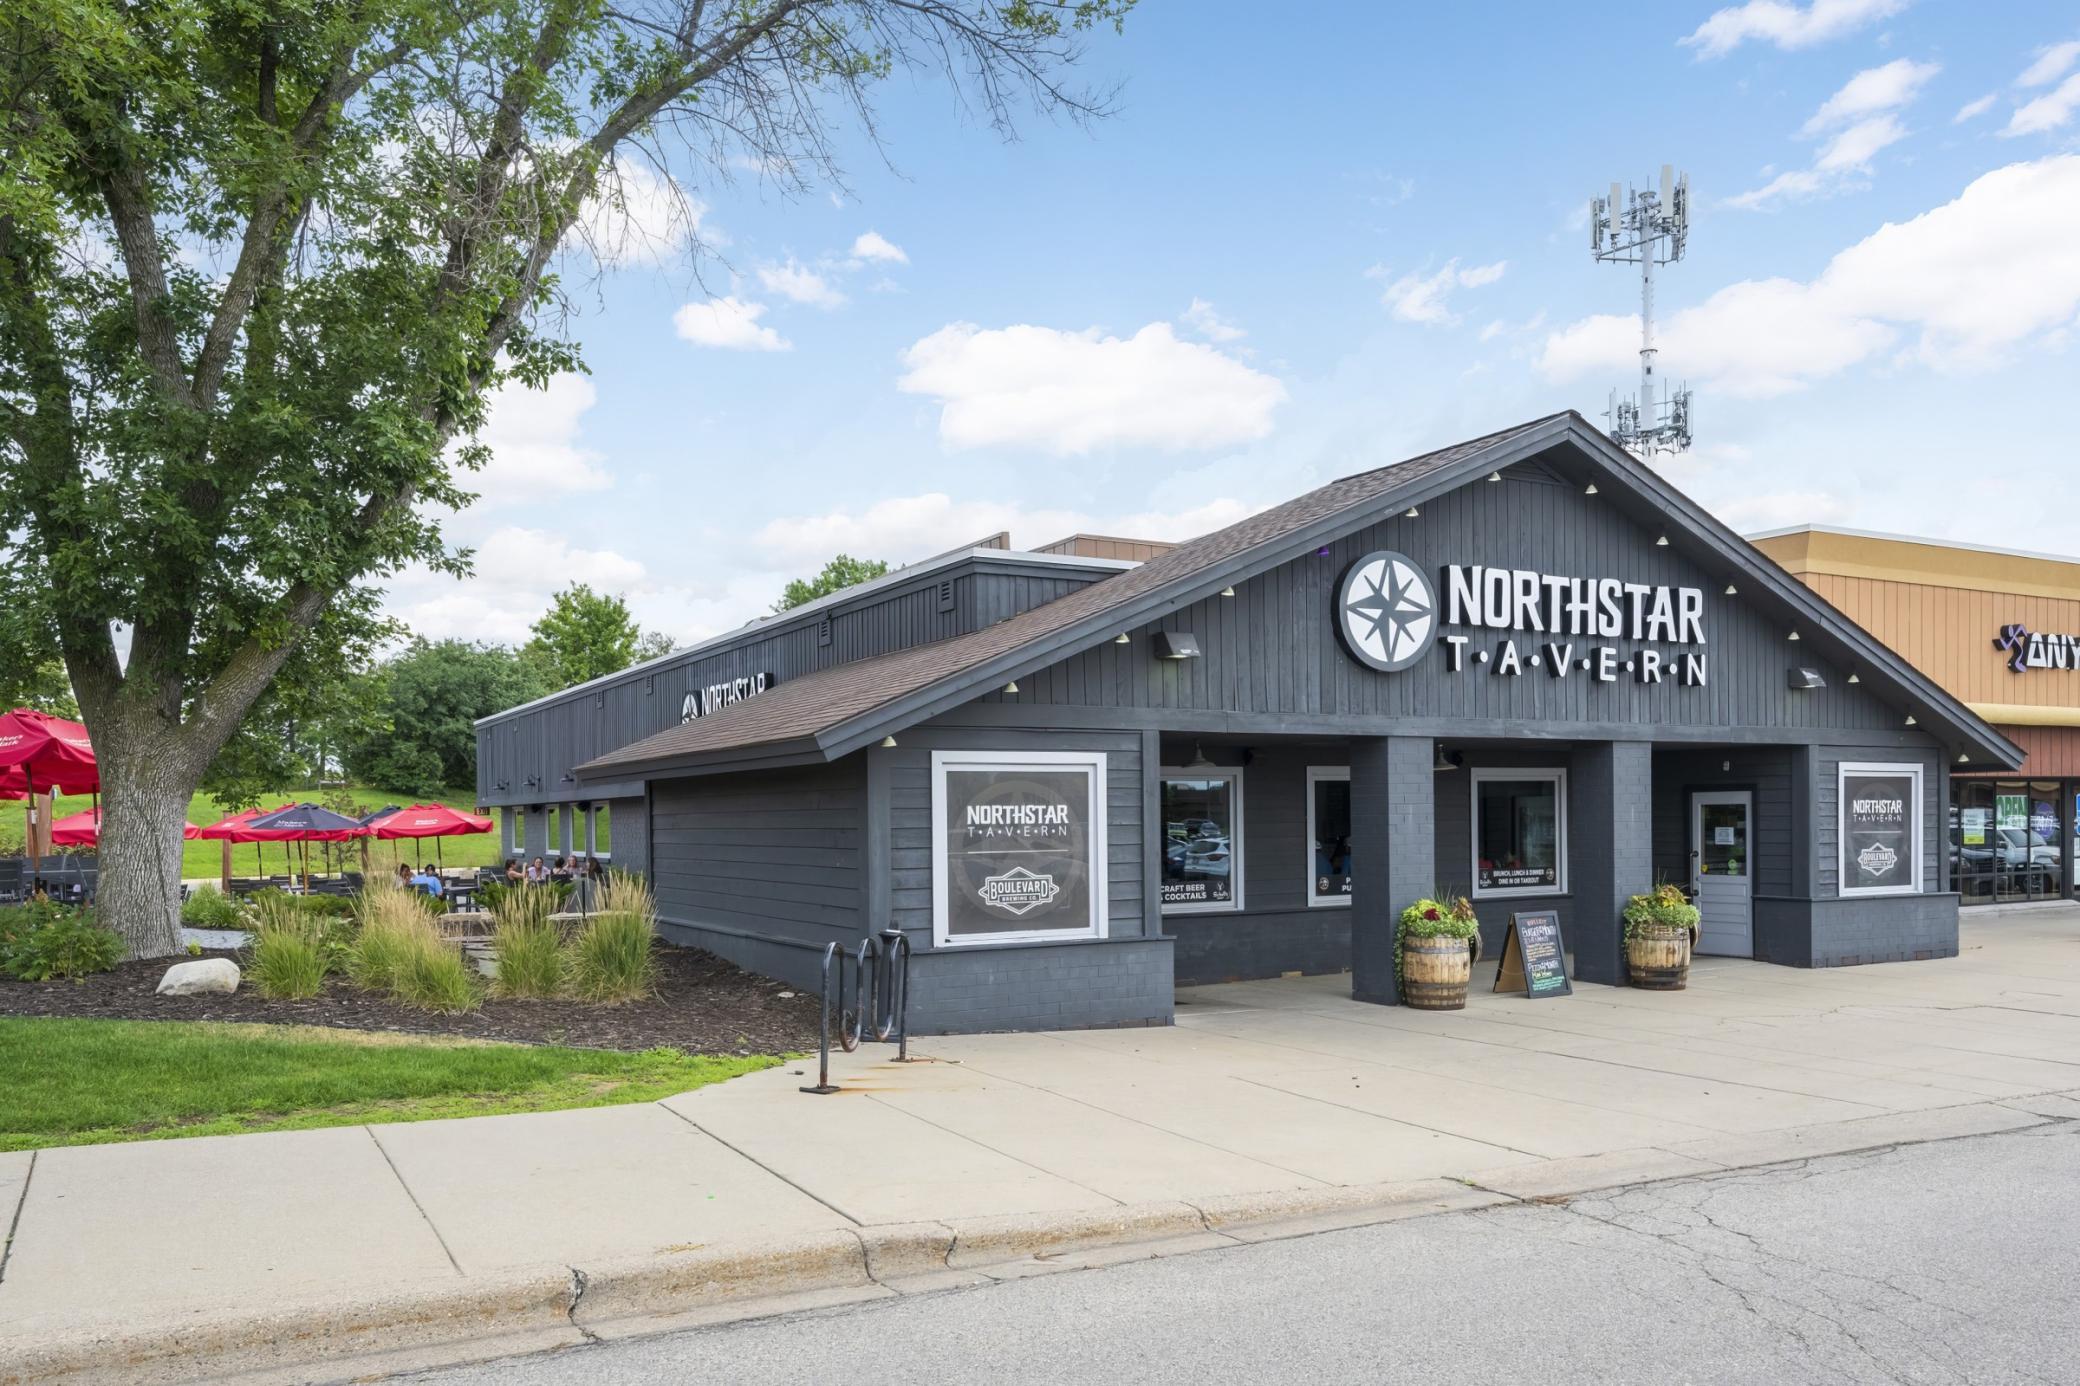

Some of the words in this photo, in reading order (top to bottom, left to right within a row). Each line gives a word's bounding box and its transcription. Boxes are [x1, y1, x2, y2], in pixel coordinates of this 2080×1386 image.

[1447, 564, 1706, 644] NORTHSTAR
[701, 672, 765, 717] NORTHSTAR
[967, 805, 1069, 825] NORTHSTAR
[1853, 800, 1902, 814] NORTHSTAR
[990, 880, 1048, 900] BOULEVARD
[1161, 885, 1184, 893] CRAFT
[1185, 884, 1205, 892] BEER
[1165, 892, 1207, 901] COCKTAILS
